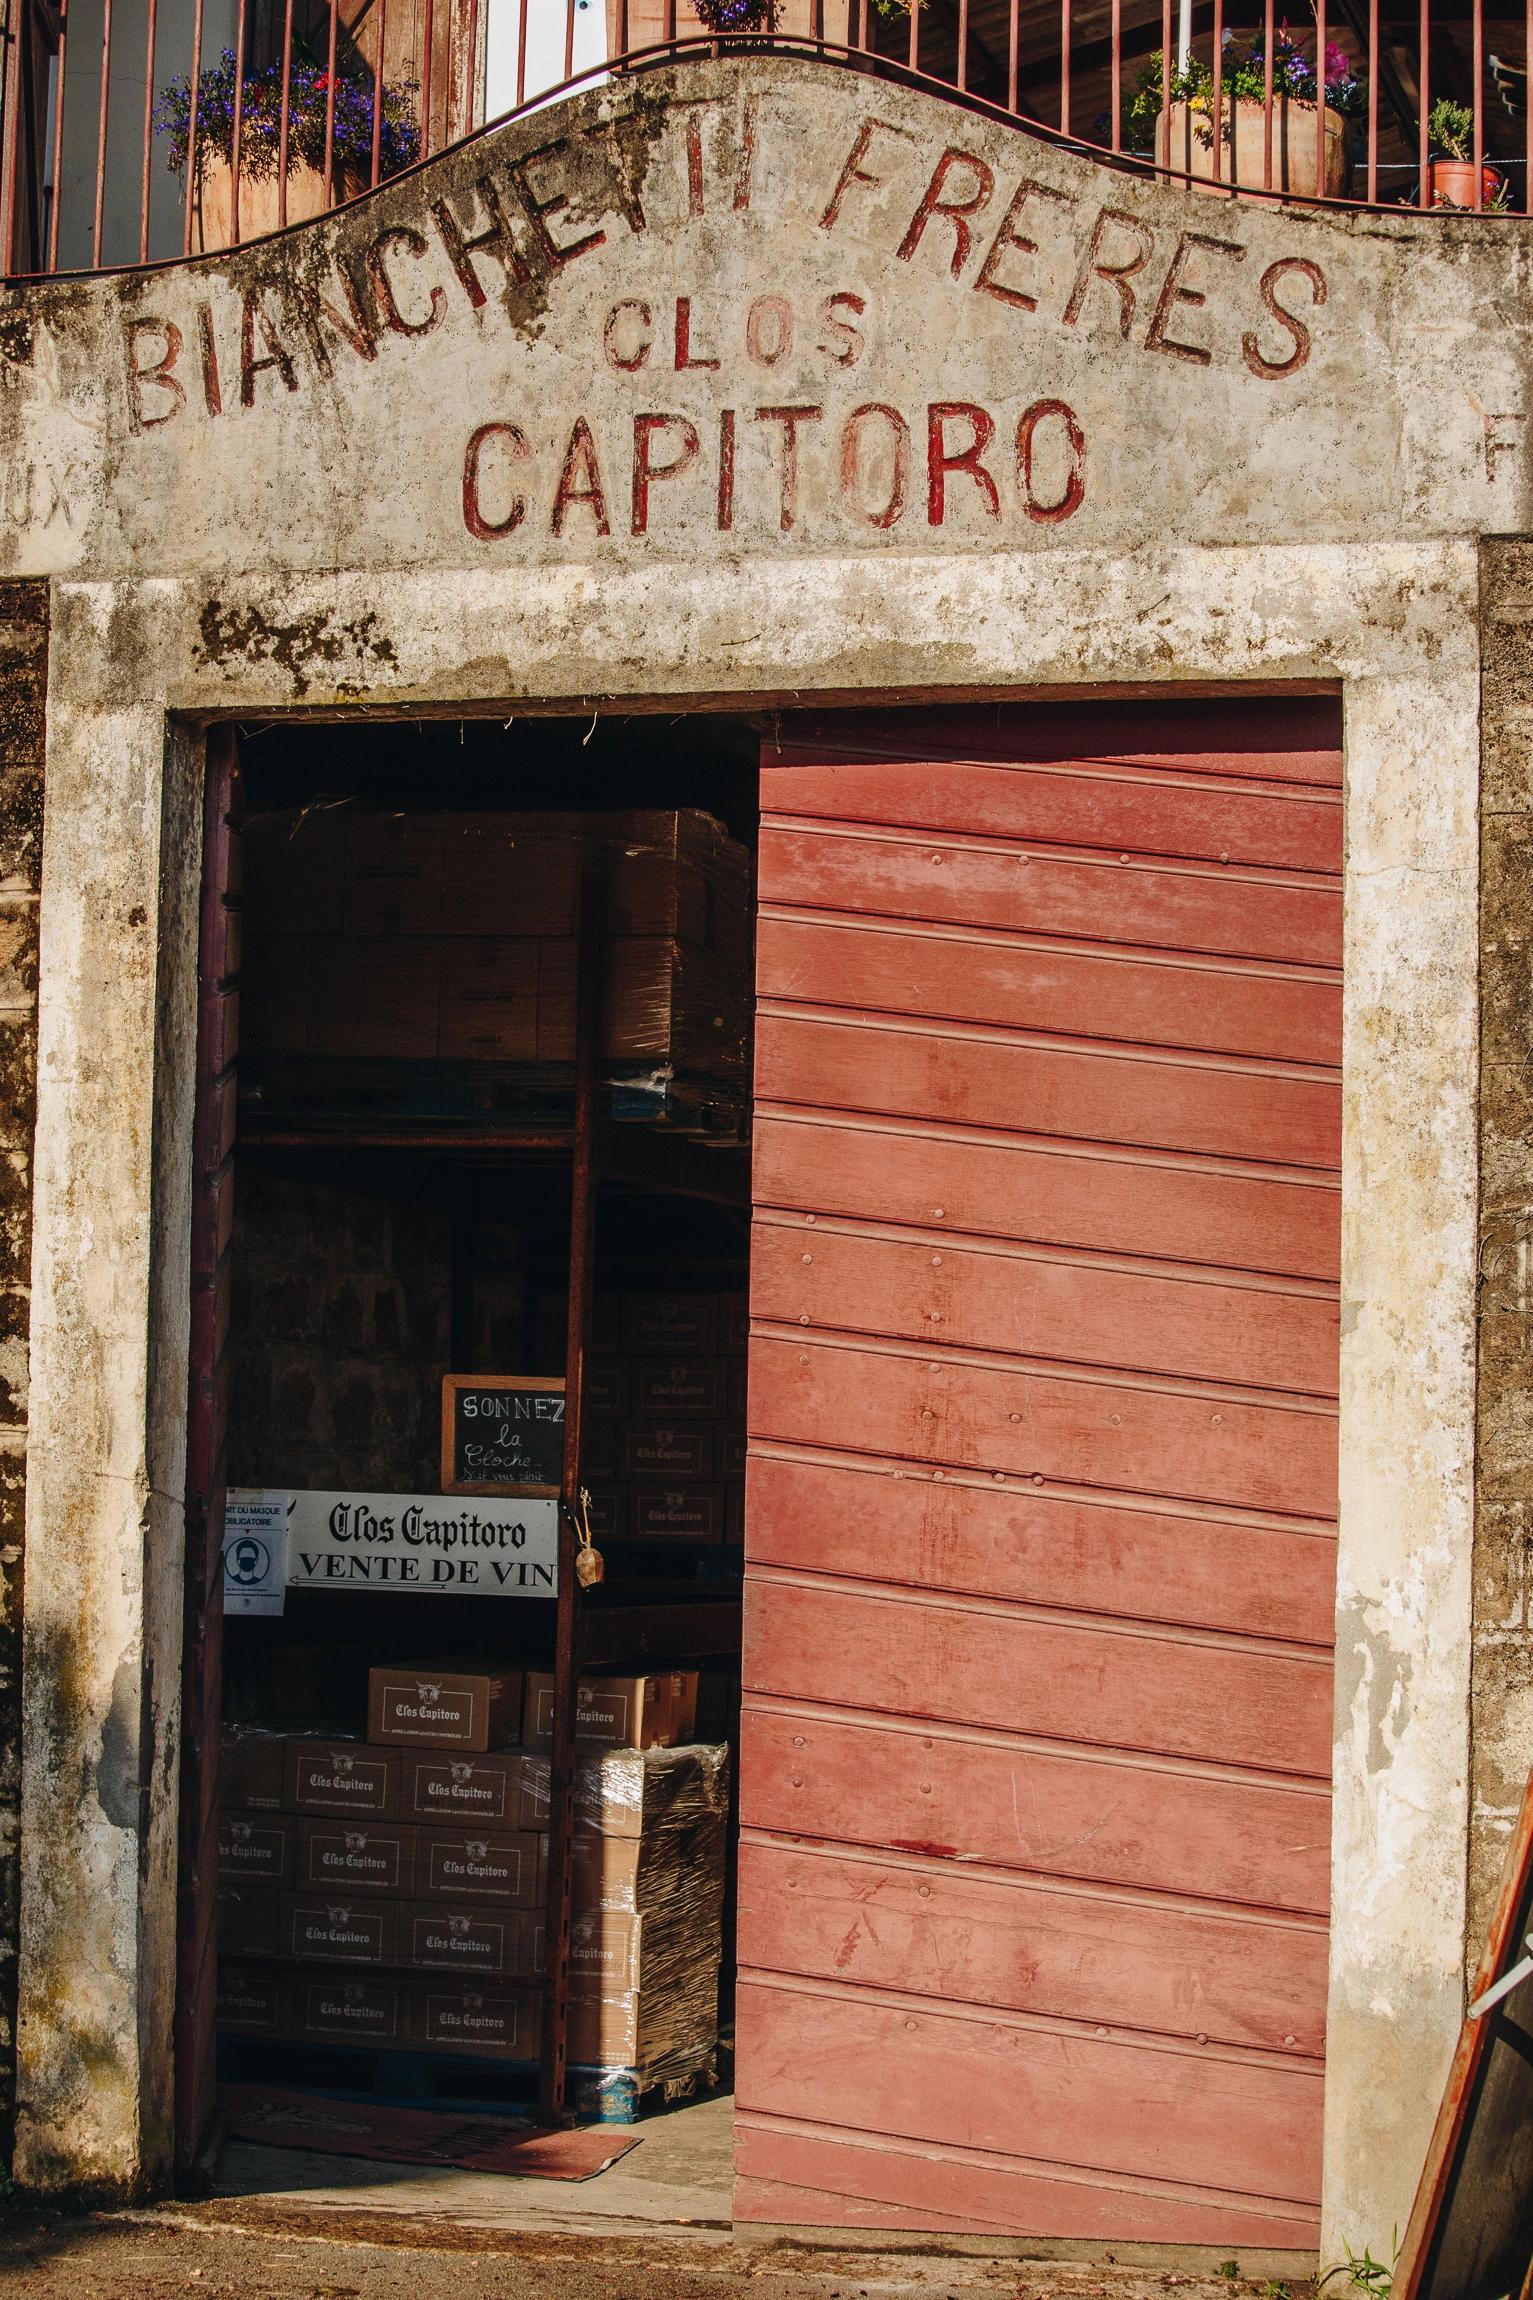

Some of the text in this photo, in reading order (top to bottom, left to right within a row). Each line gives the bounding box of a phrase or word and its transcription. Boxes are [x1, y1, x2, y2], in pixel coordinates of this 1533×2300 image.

[818, 115, 1328, 381] FRERES
[604, 291, 866, 373] CLOS
[462, 399, 1087, 541] CAPITORO
[463, 1395, 565, 1422] SONNEZ
[494, 1424, 522, 1447] la
[224, 1518, 272, 1526] OBLIGATOIRE
[250, 1507, 281, 1515] MASQUE
[329, 1502, 526, 1552] Clos Capitoro
[299, 1553, 556, 1587] VENTE DE VIN
[395, 1704, 460, 1721] Clos Capitoro
